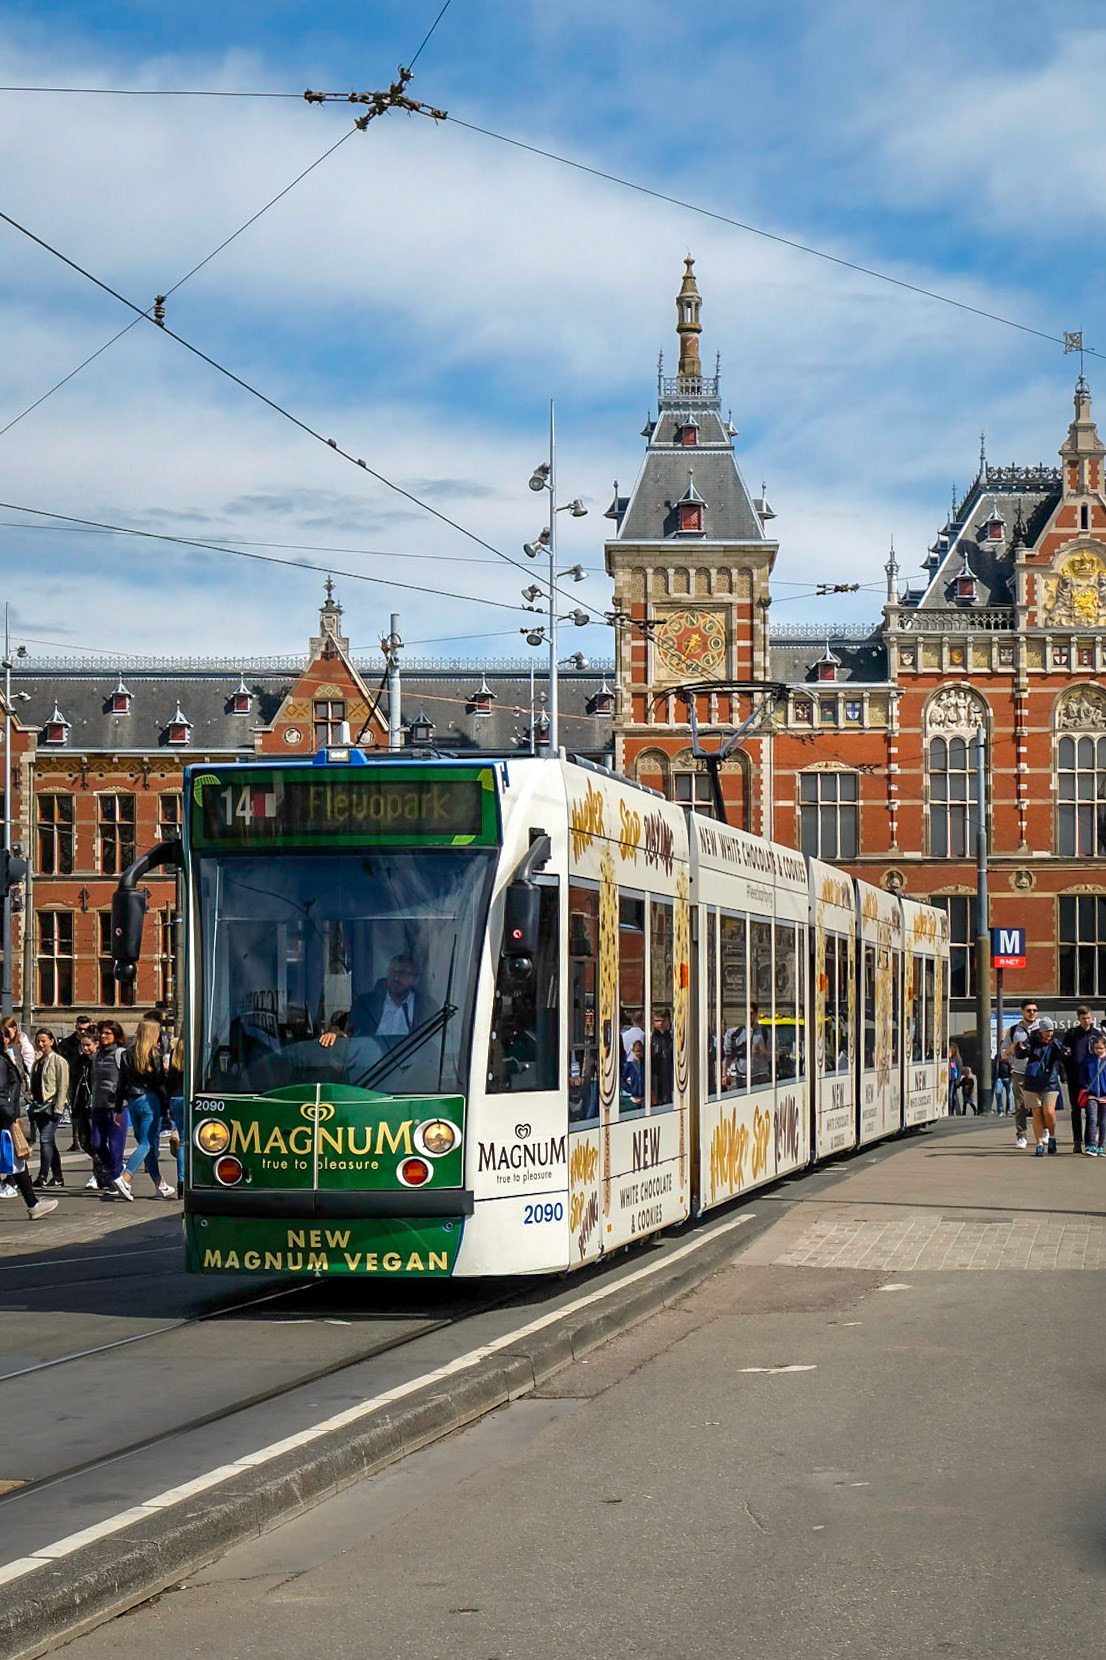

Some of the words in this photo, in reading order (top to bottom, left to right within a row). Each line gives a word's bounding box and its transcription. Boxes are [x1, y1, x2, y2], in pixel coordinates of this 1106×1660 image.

[220, 785, 253, 825] 14
[699, 826, 718, 856] NEW
[718, 833, 741, 865] WHITE
[742, 841, 777, 876] CHOCOLATE
[783, 855, 806, 884] COOKIES
[999, 930, 1020, 954] M
[195, 1101, 225, 1112] 2090
[229, 1119, 415, 1155] MAGNUM
[632, 1126, 661, 1174] NEW
[262, 1158, 288, 1170] true
[294, 1158, 308, 1170] to
[478, 1135, 567, 1172] MAGNUM
[496, 1175, 511, 1184] true
[513, 1173, 521, 1182] to
[523, 1169, 553, 1184] pleasure
[620, 1184, 639, 1209] WHITE
[640, 1173, 672, 1202] CHOCOLATE
[524, 1202, 564, 1224] 2090
[631, 1214, 636, 1234] &
[637, 1203, 663, 1231] COOKIES
[287, 1230, 351, 1248] NEW
[203, 1249, 329, 1271] MAGNUM
[343, 1251, 448, 1271] VEGAN
